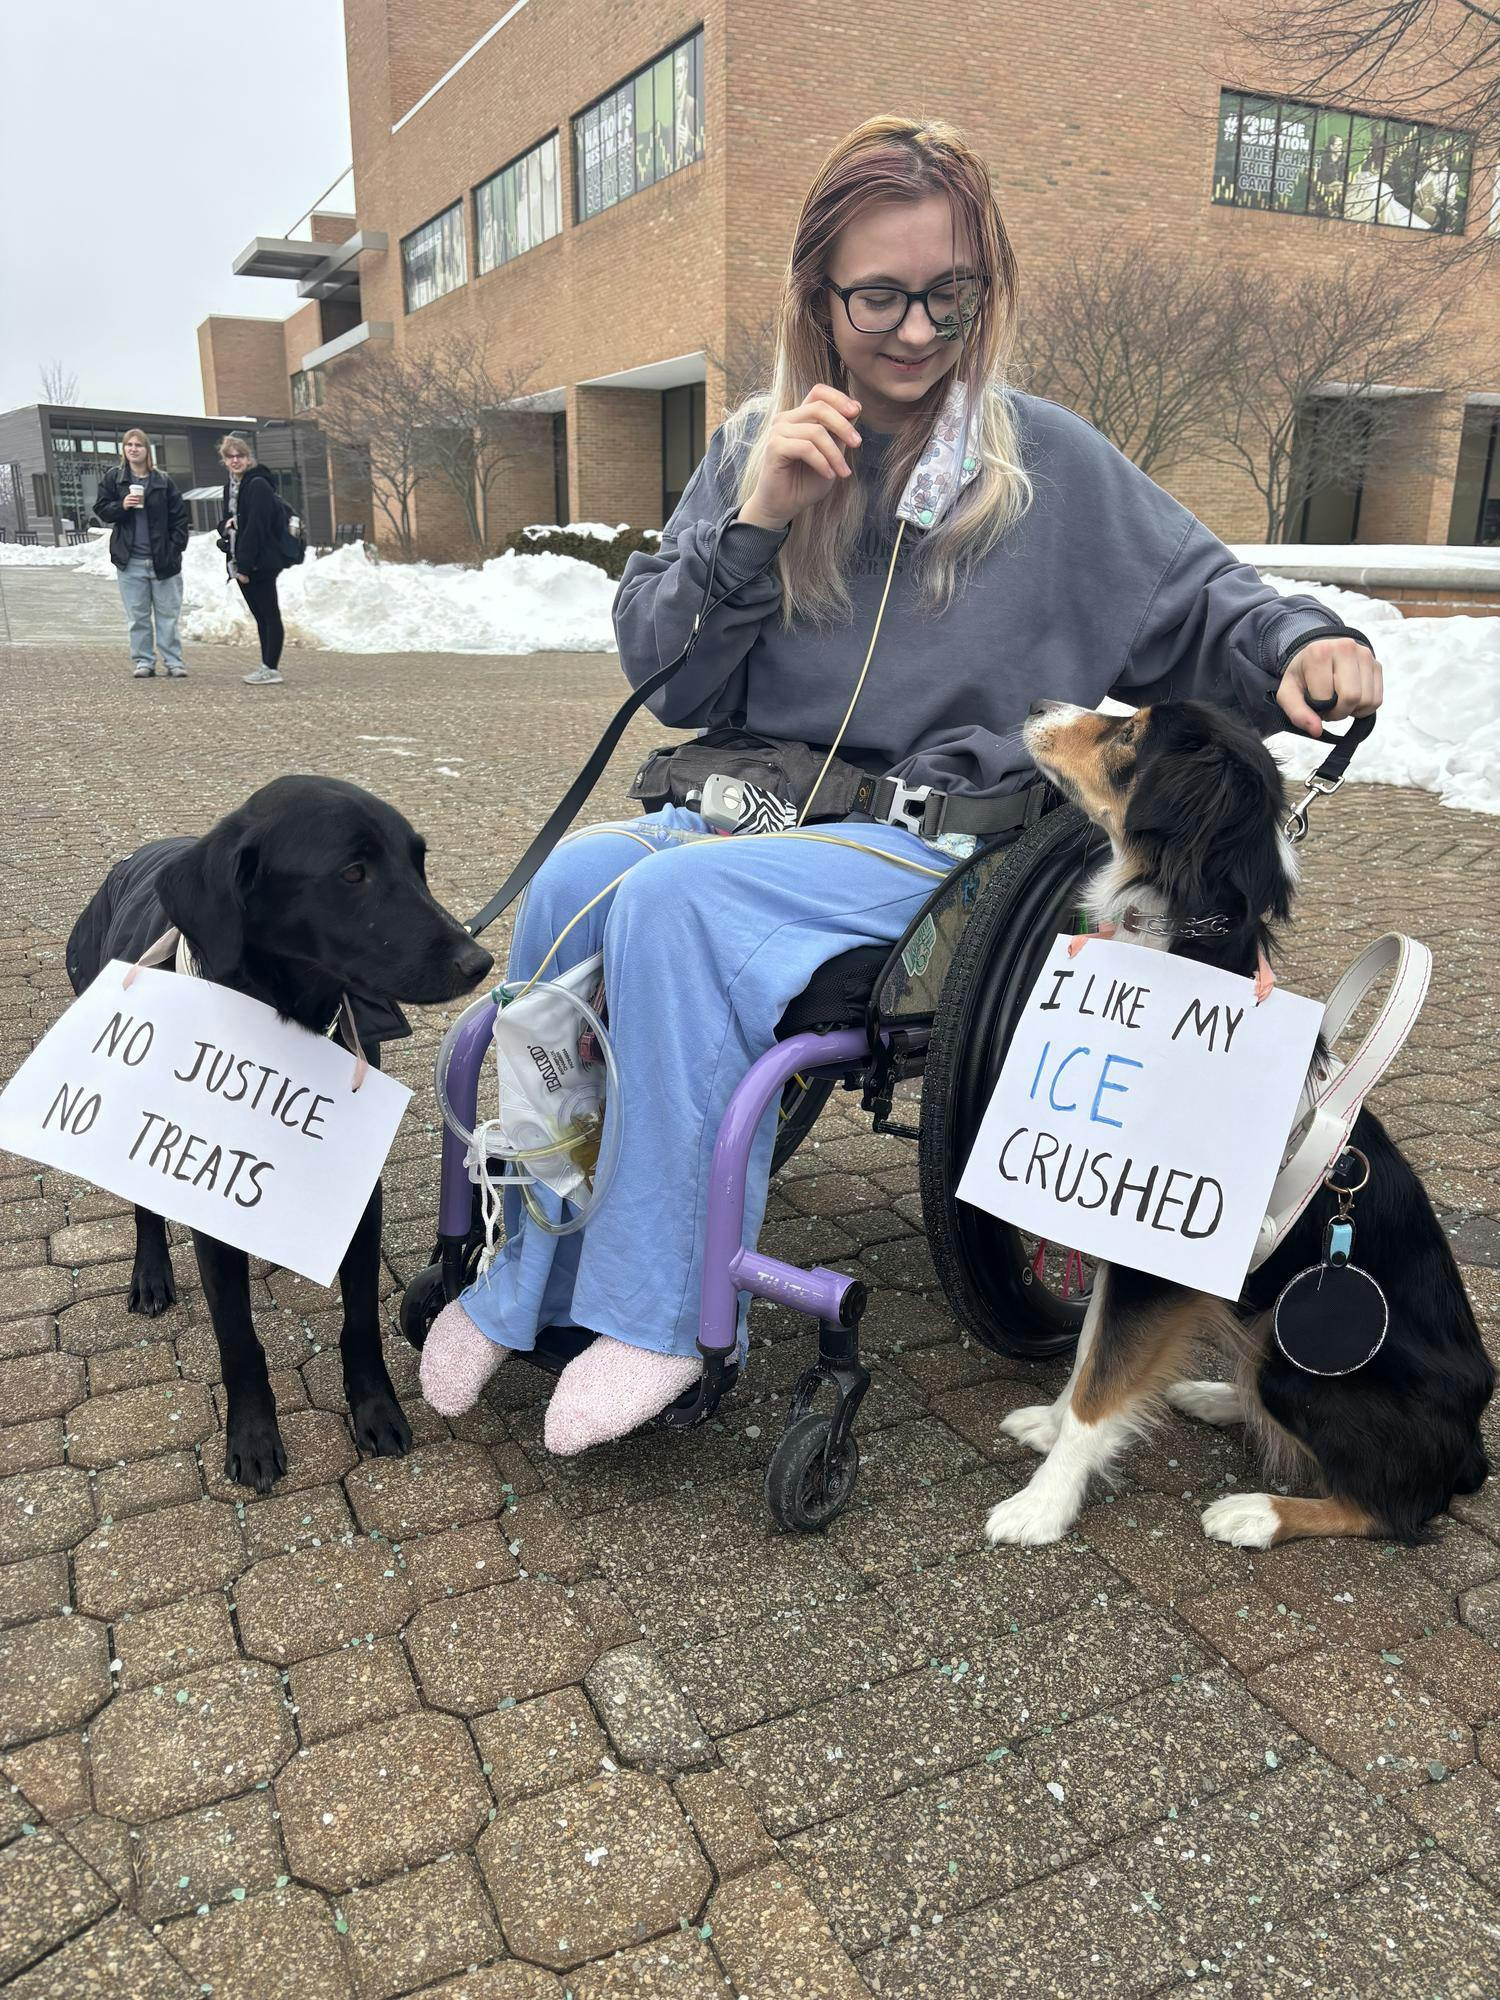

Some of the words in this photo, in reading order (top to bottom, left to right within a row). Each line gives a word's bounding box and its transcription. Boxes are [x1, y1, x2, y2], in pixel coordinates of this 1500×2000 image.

[1240, 144, 1322, 171] WHEELCHAR
[1258, 134, 1310, 151] NATION
[1259, 117, 1276, 134] IN
[1280, 121, 1306, 138] THE
[1239, 175, 1295, 197] CAMUS
[1039, 970, 1074, 1011] I
[1078, 974, 1151, 1029] LIKE
[1171, 998, 1244, 1053] MY
[91, 1011, 154, 1067] NO
[173, 1040, 335, 1140] JUSTICE
[1029, 1040, 1144, 1129] ICE
[41, 1081, 102, 1136] NO
[128, 1110, 275, 1208] TREATS
[998, 1127, 1224, 1239] CRUSHED
